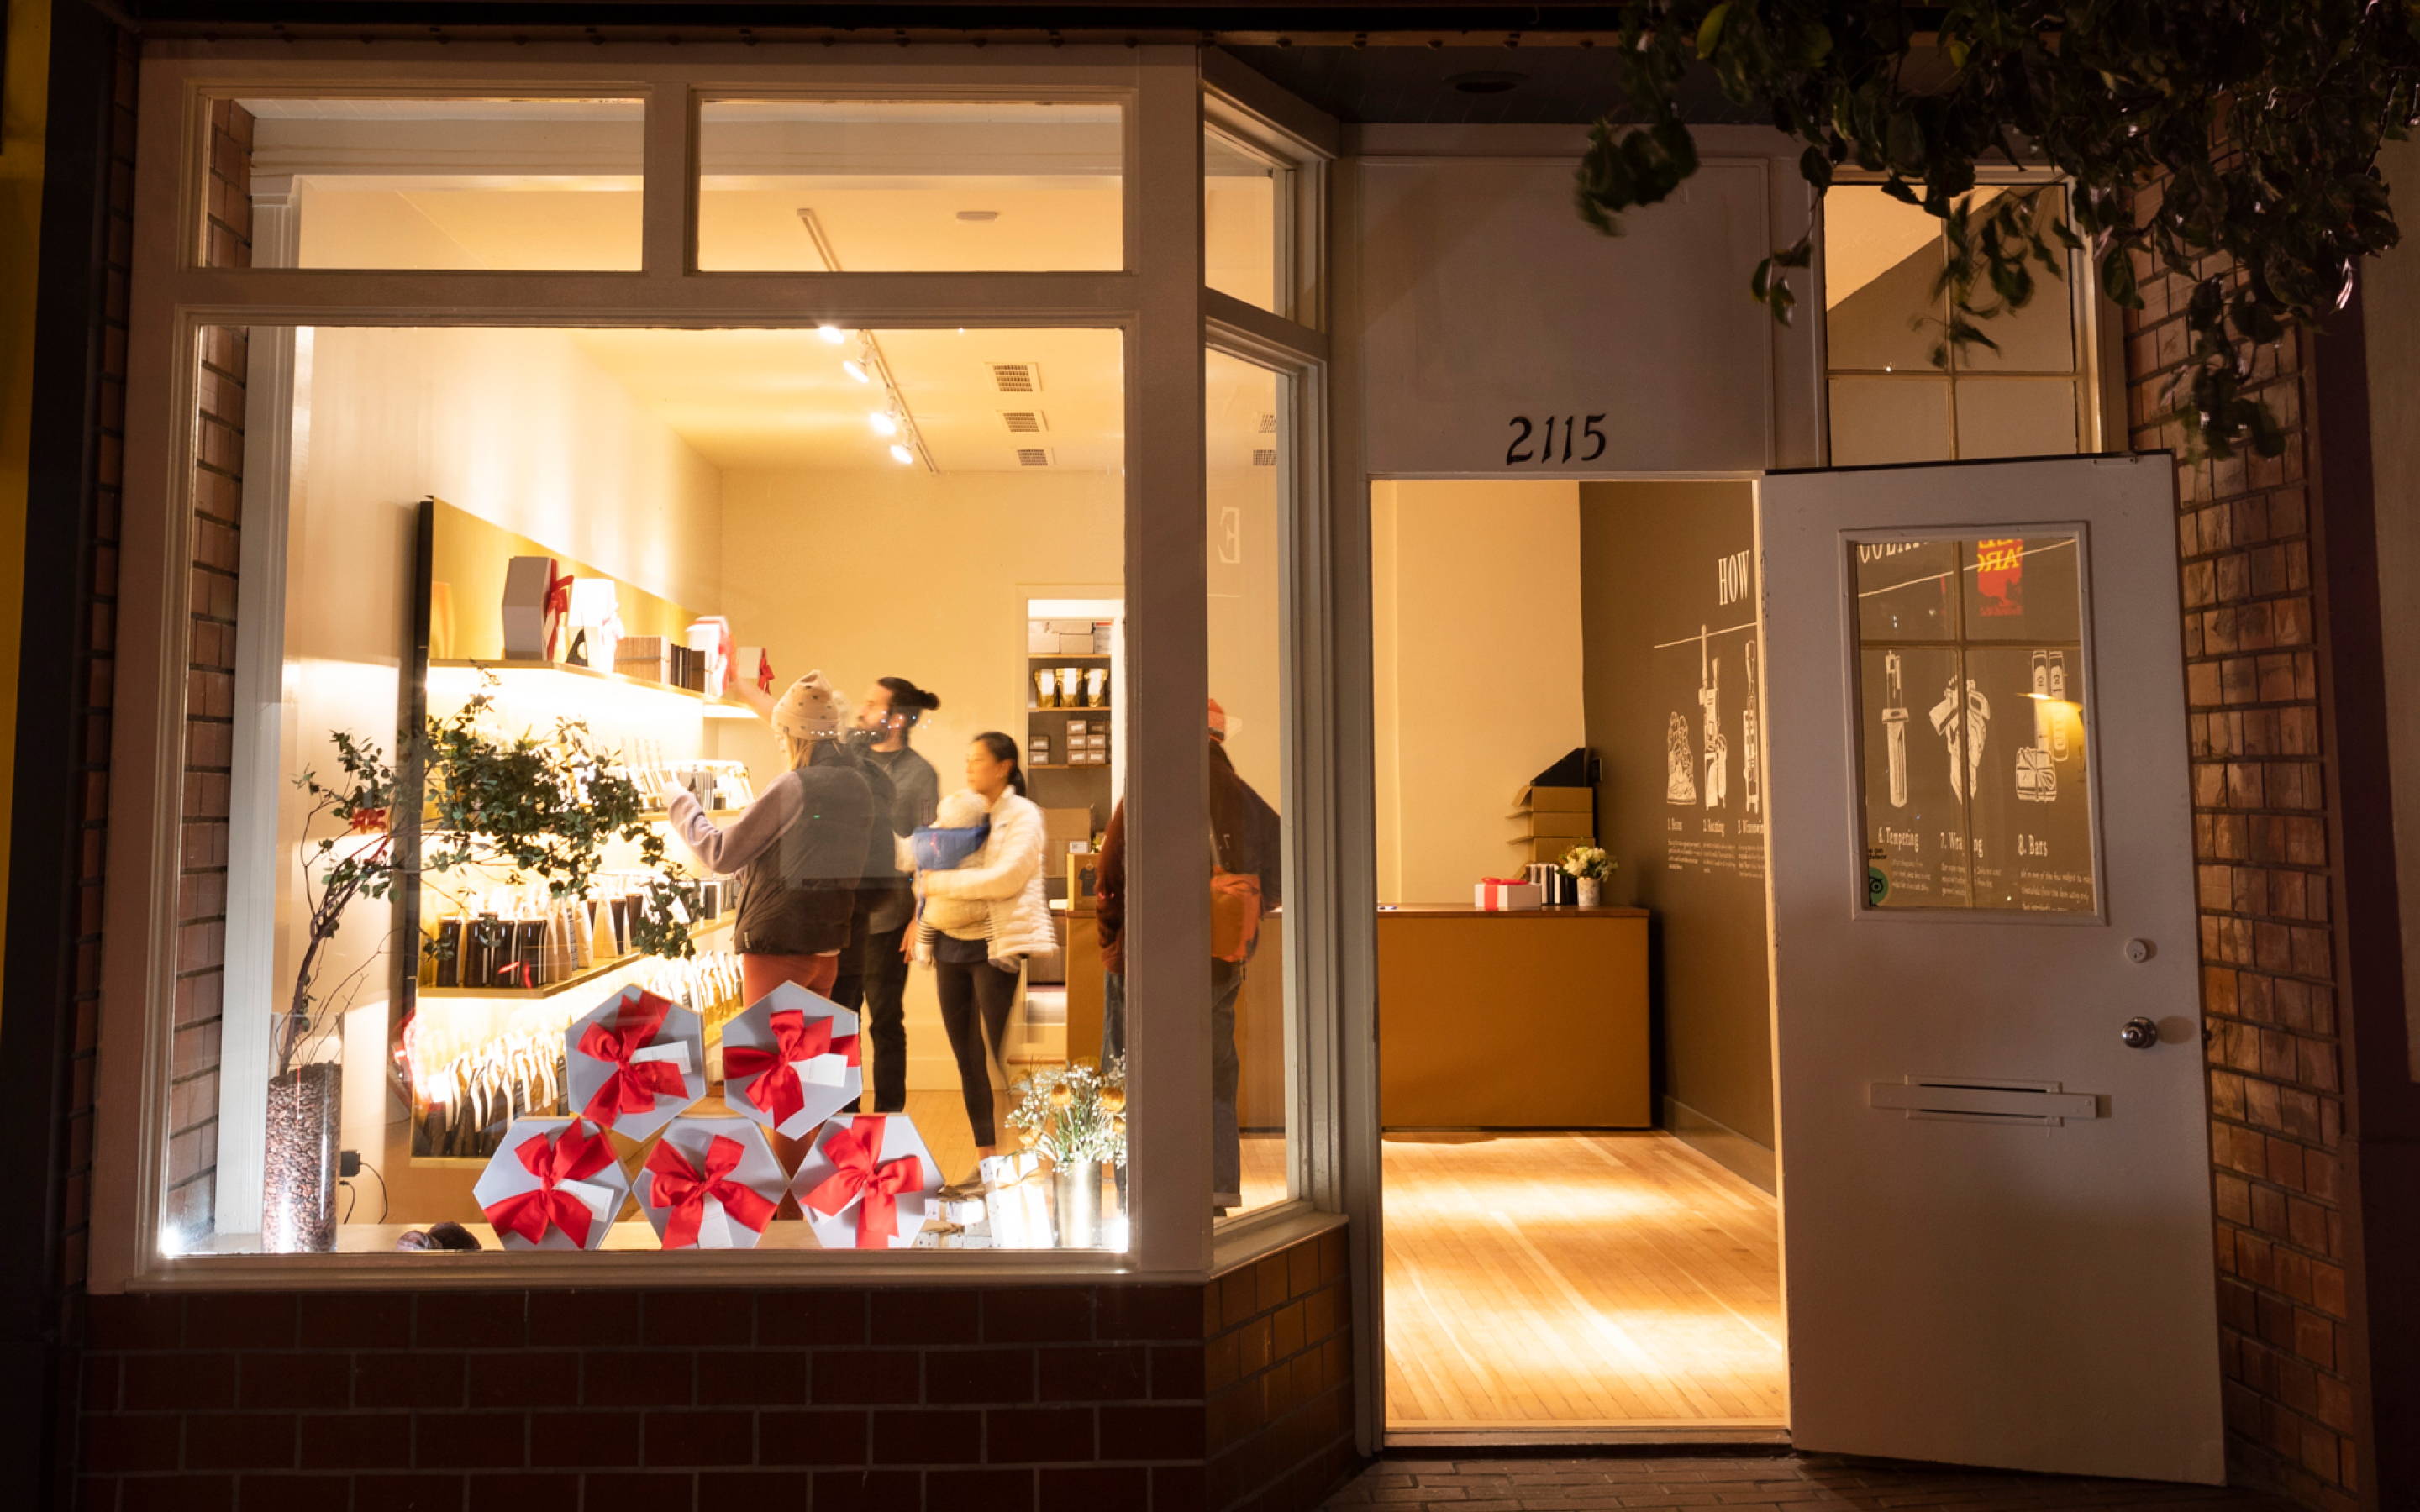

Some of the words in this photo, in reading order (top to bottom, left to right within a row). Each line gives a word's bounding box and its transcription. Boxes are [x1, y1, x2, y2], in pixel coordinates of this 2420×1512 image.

[1506, 412, 1607, 465] 2115
[1717, 549, 1749, 606] HOW
[2028, 834, 2049, 857] Bars
